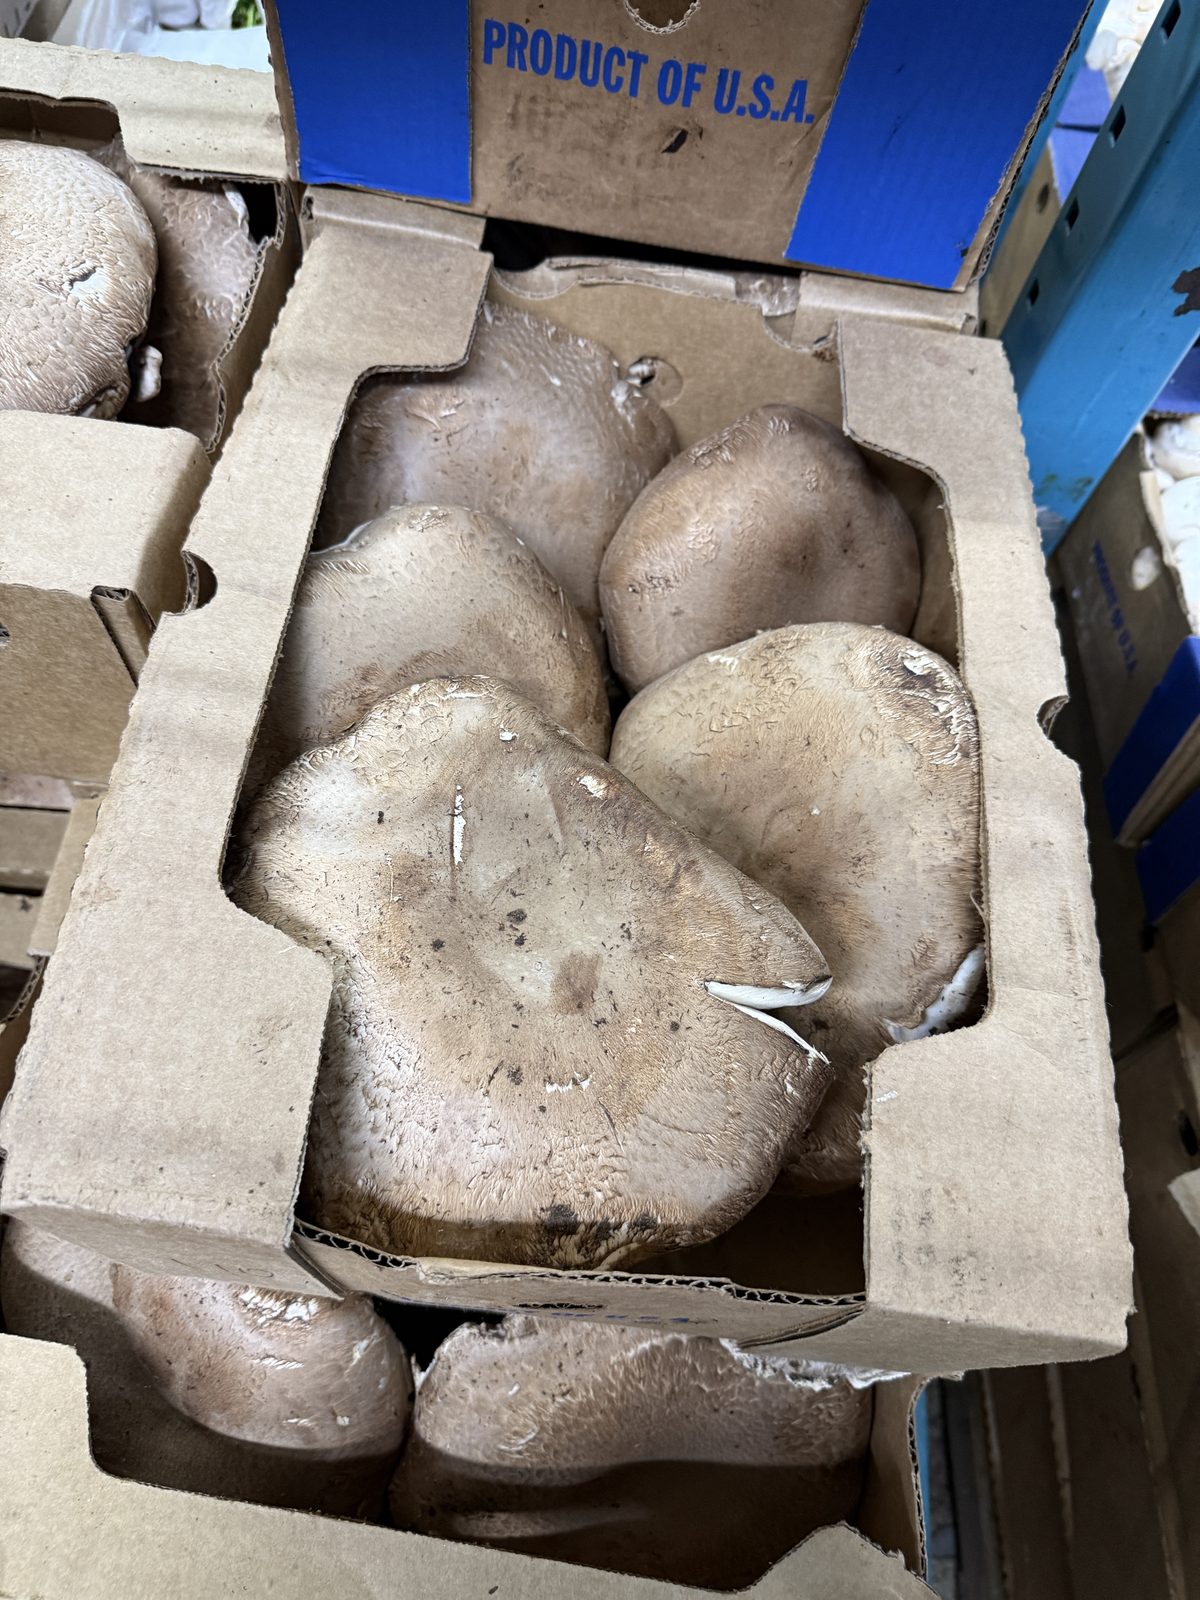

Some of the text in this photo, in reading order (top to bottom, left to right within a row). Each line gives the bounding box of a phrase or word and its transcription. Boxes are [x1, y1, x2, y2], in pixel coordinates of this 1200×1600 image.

[483, 18, 815, 124] PRODUCT OF U.S.A.
